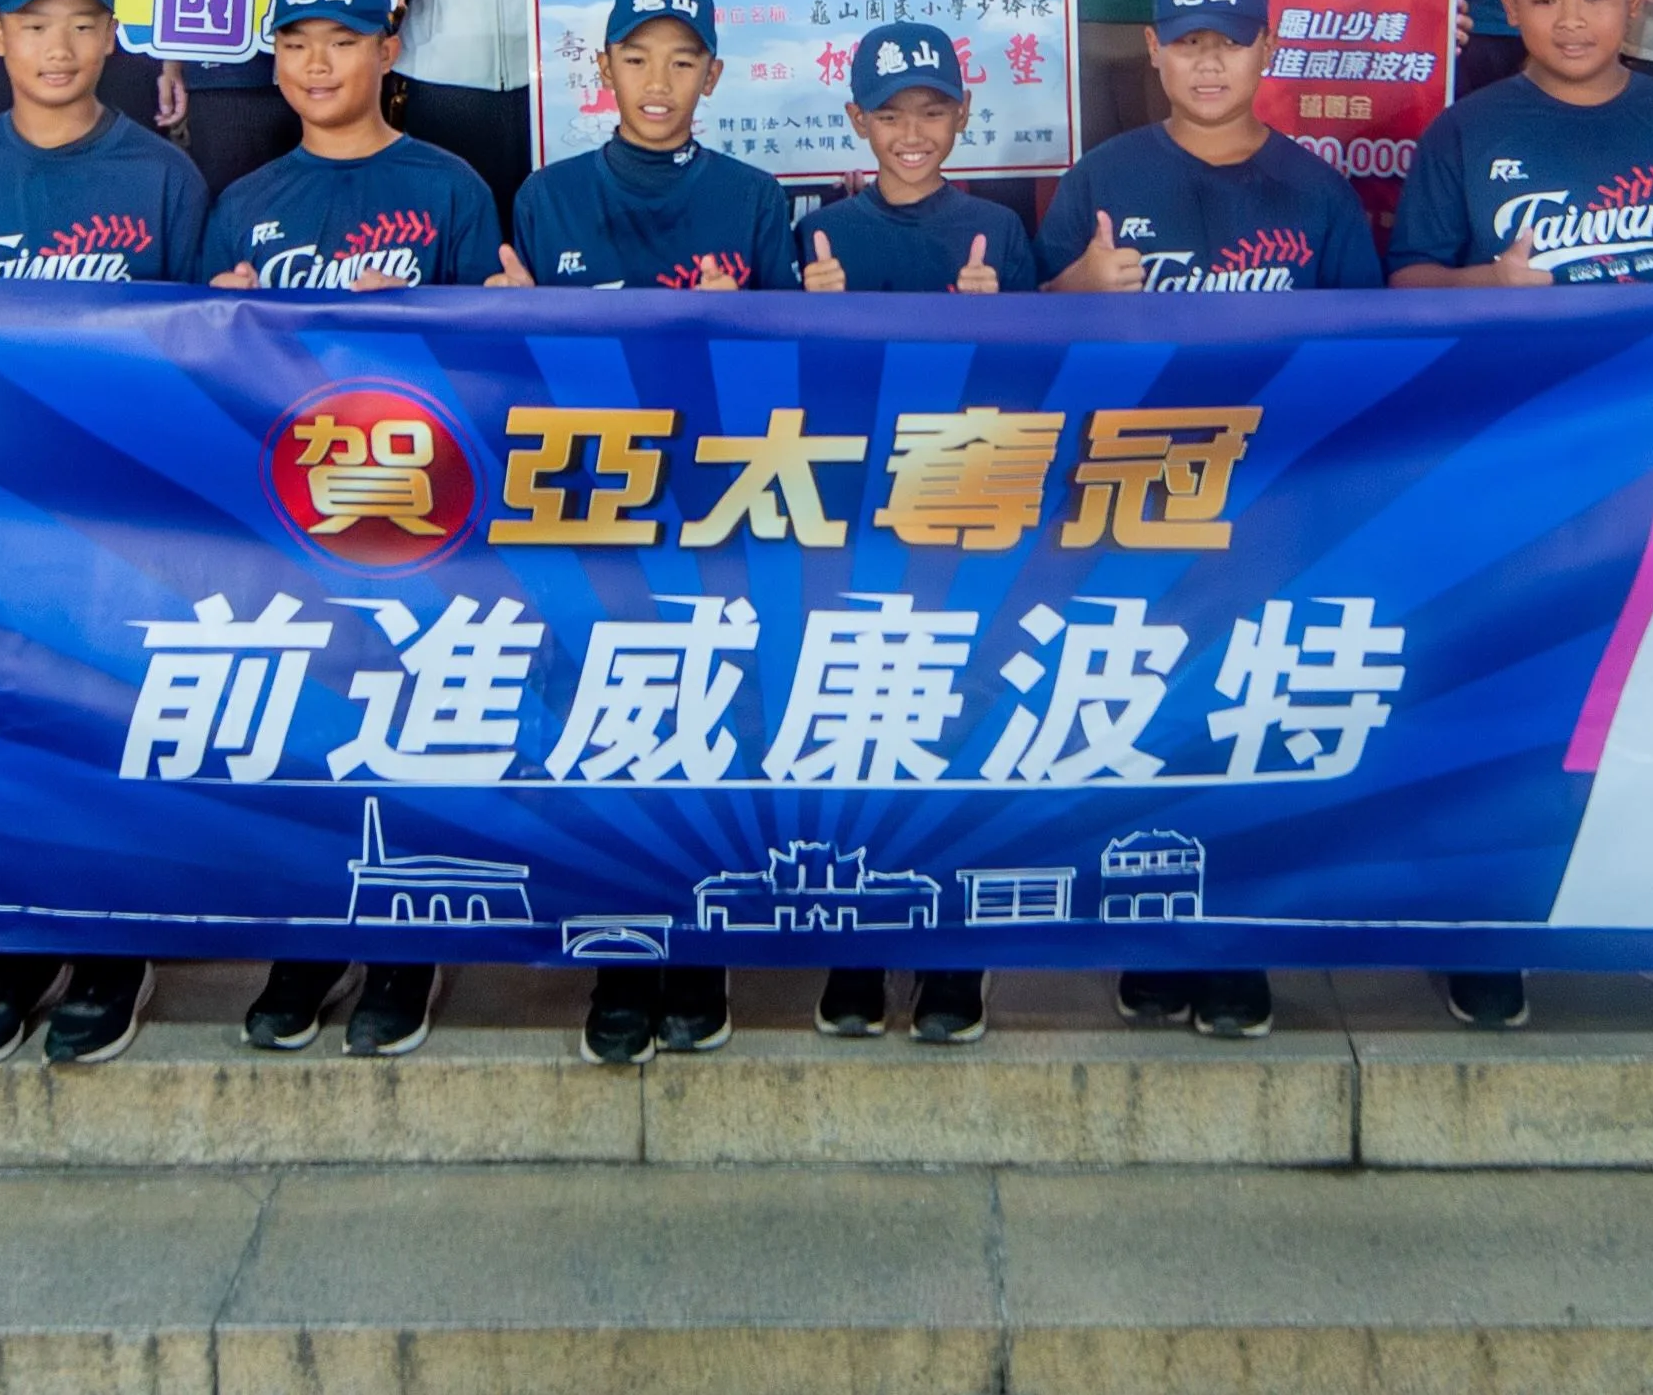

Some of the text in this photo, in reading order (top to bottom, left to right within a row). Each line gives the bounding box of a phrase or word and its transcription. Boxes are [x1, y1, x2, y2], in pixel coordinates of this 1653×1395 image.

[1260, 48, 1436, 82] 進威廉波特
[1277, 8, 1409, 43] 龜山少棒
[295, 404, 1264, 550] 賀 亞太奪冠
[118, 590, 1407, 784] 前進威廉波特
